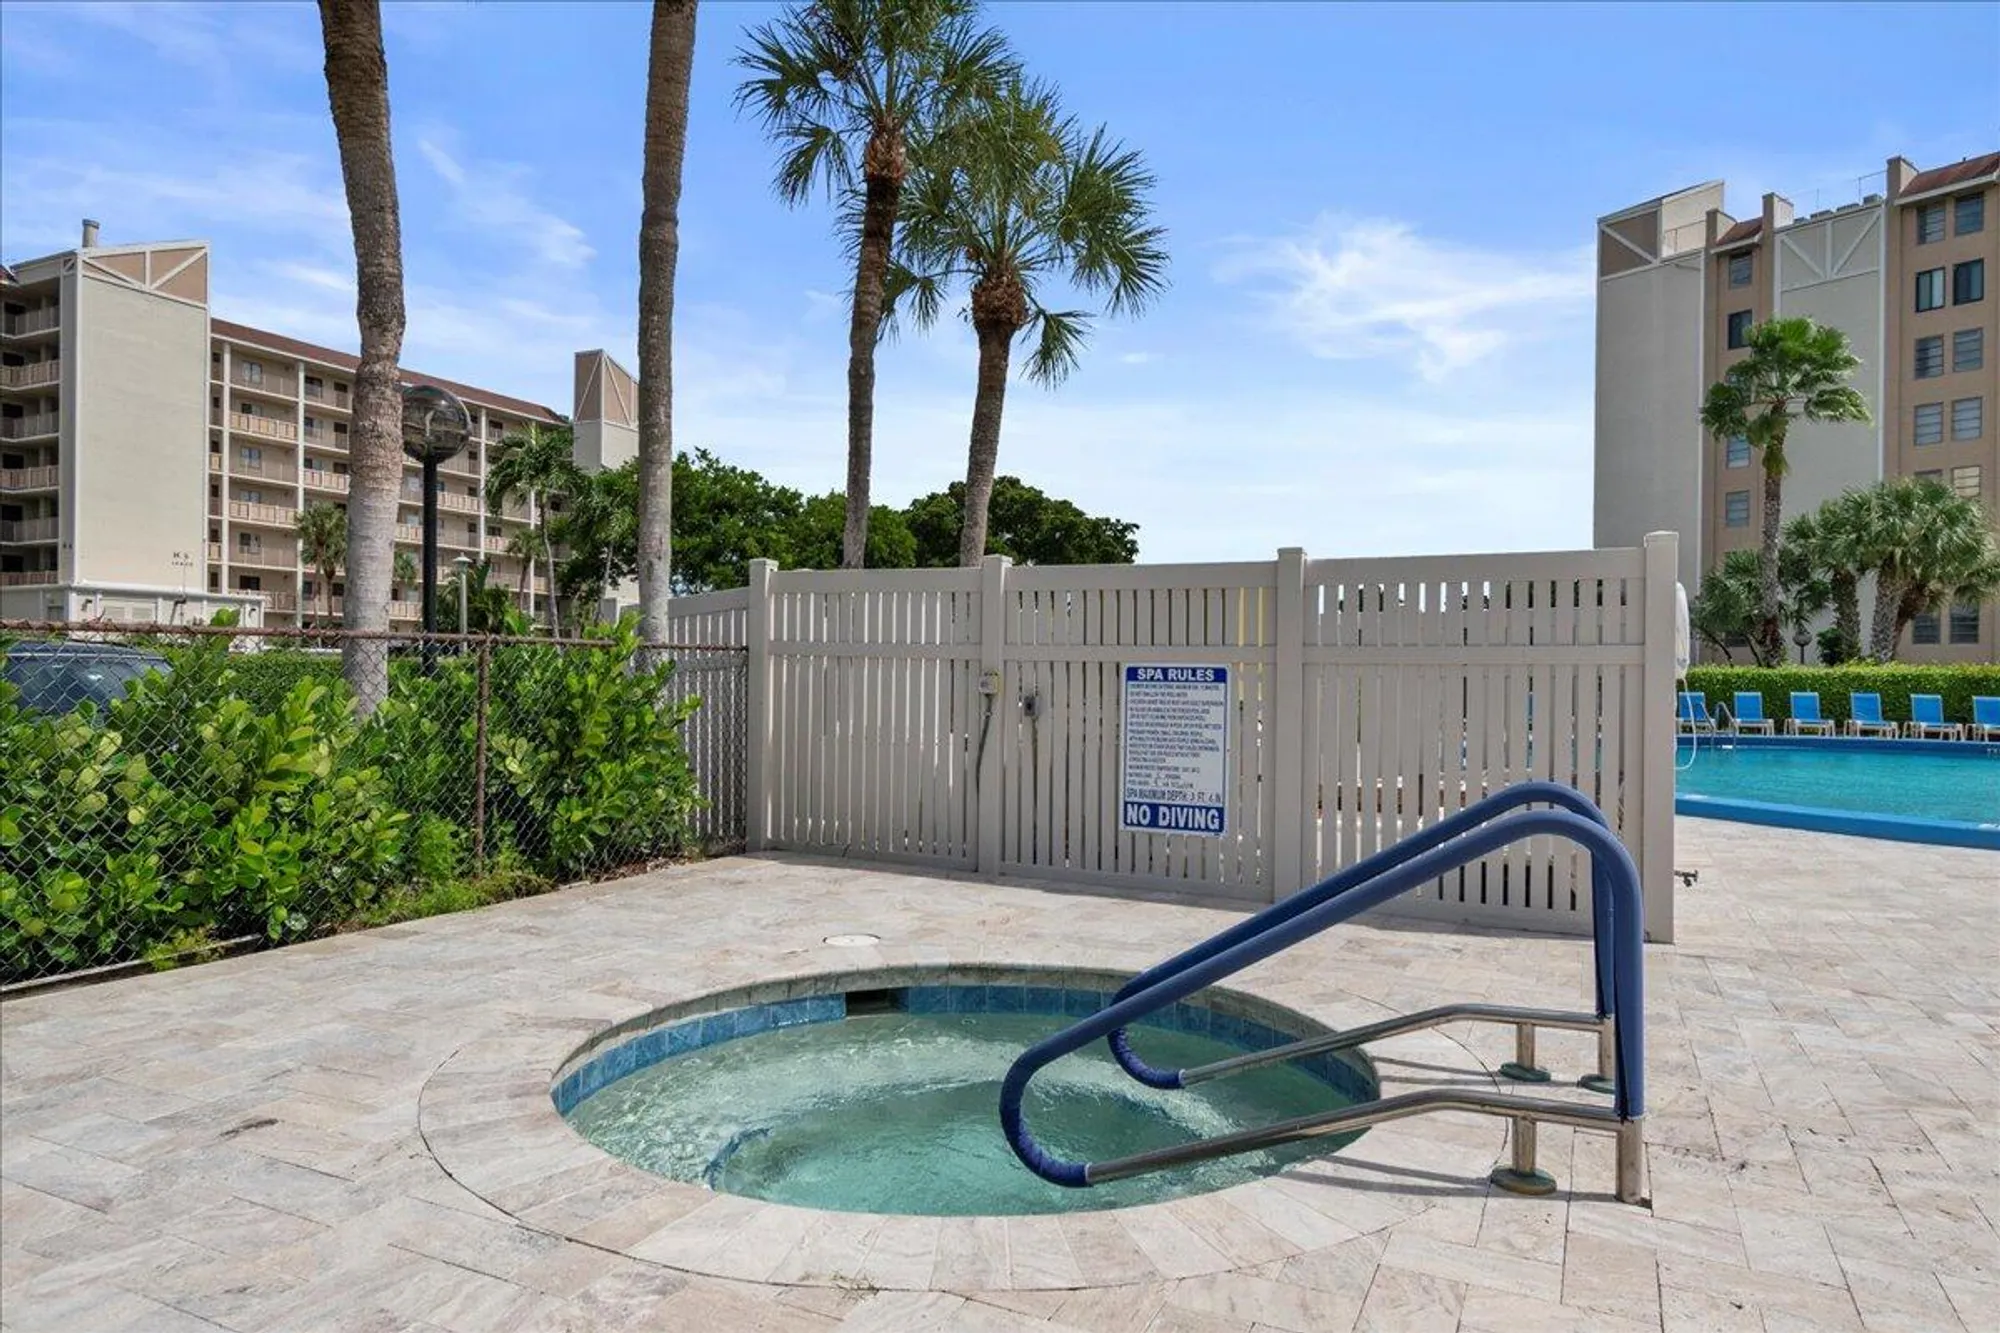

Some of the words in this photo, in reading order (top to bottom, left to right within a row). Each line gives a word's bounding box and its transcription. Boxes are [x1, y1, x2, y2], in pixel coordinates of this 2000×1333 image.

[1137, 668, 1164, 680] SPA
[1168, 668, 1215, 681] RULES
[1127, 804, 1151, 825] NO
[1158, 805, 1220, 830] DIVING
